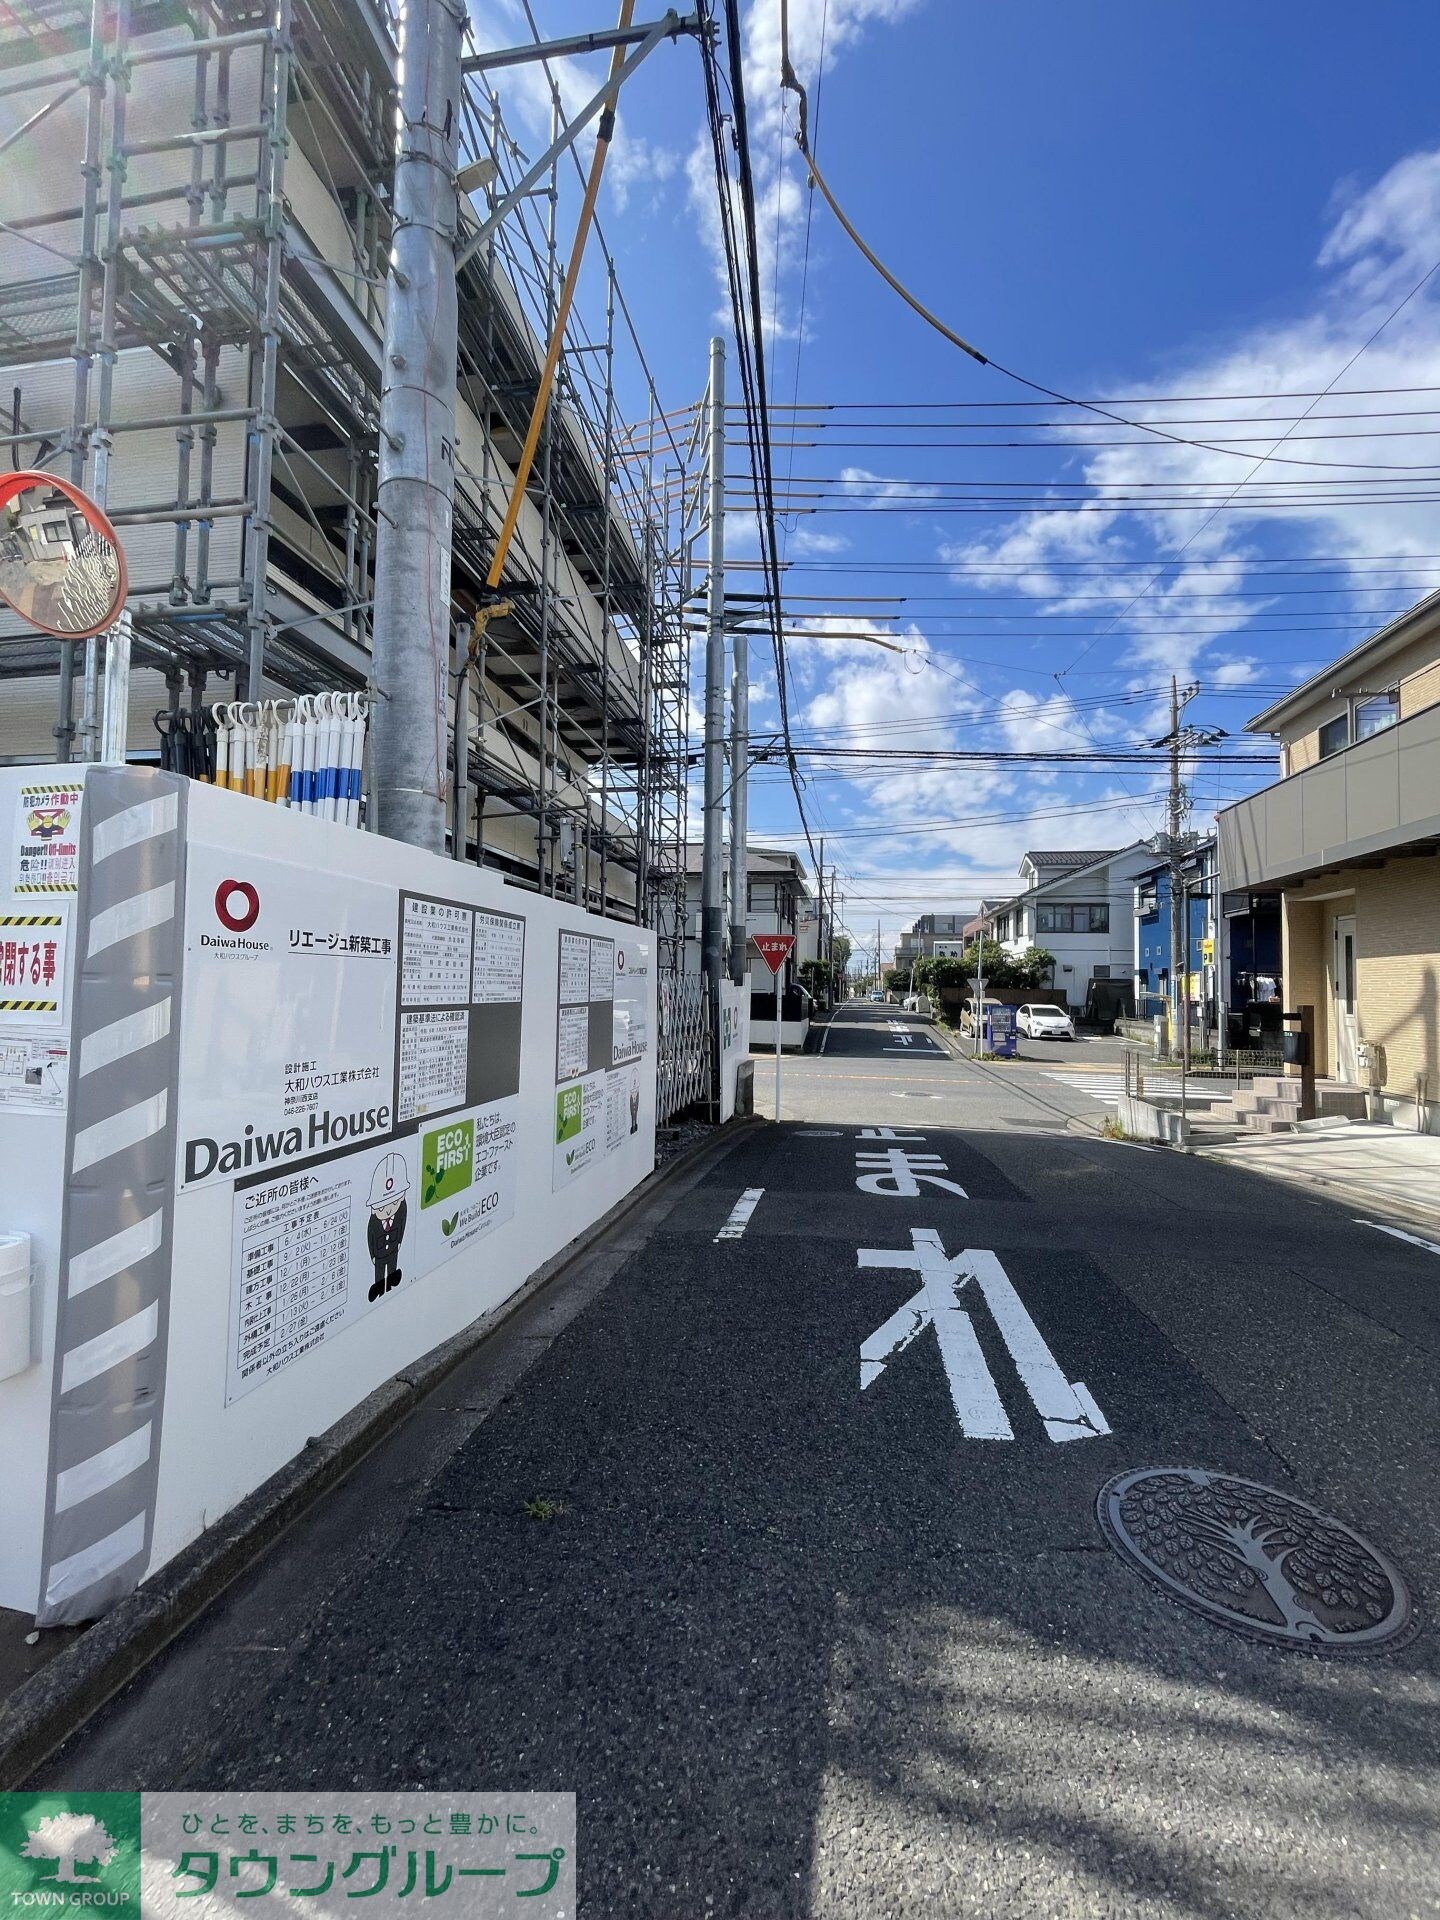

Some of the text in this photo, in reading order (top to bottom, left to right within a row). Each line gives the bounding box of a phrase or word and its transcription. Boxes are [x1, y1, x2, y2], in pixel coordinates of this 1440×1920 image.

[23, 793, 79, 808] 防犯カメラ作動中
[201, 934, 269, 951] Daiwa House
[289, 929, 392, 955] リエージュ新築工事
[761, 942, 788, 952] 止まれ
[214, 952, 259, 961] 大和ハウスグループ
[284, 1061, 317, 1074] 設計施工
[284, 1066, 380, 1094] 大和ハウス工業株式会社
[185, 1105, 390, 1184] Daiwa House
[437, 1129, 463, 1153] ECO
[436, 1146, 470, 1173] FIRST
[245, 1176, 319, 1210] ご近所の皆様へ
[481, 1191, 499, 1214] ECO
[266, 1332, 325, 1377] 大和ハウス工業株式会社
